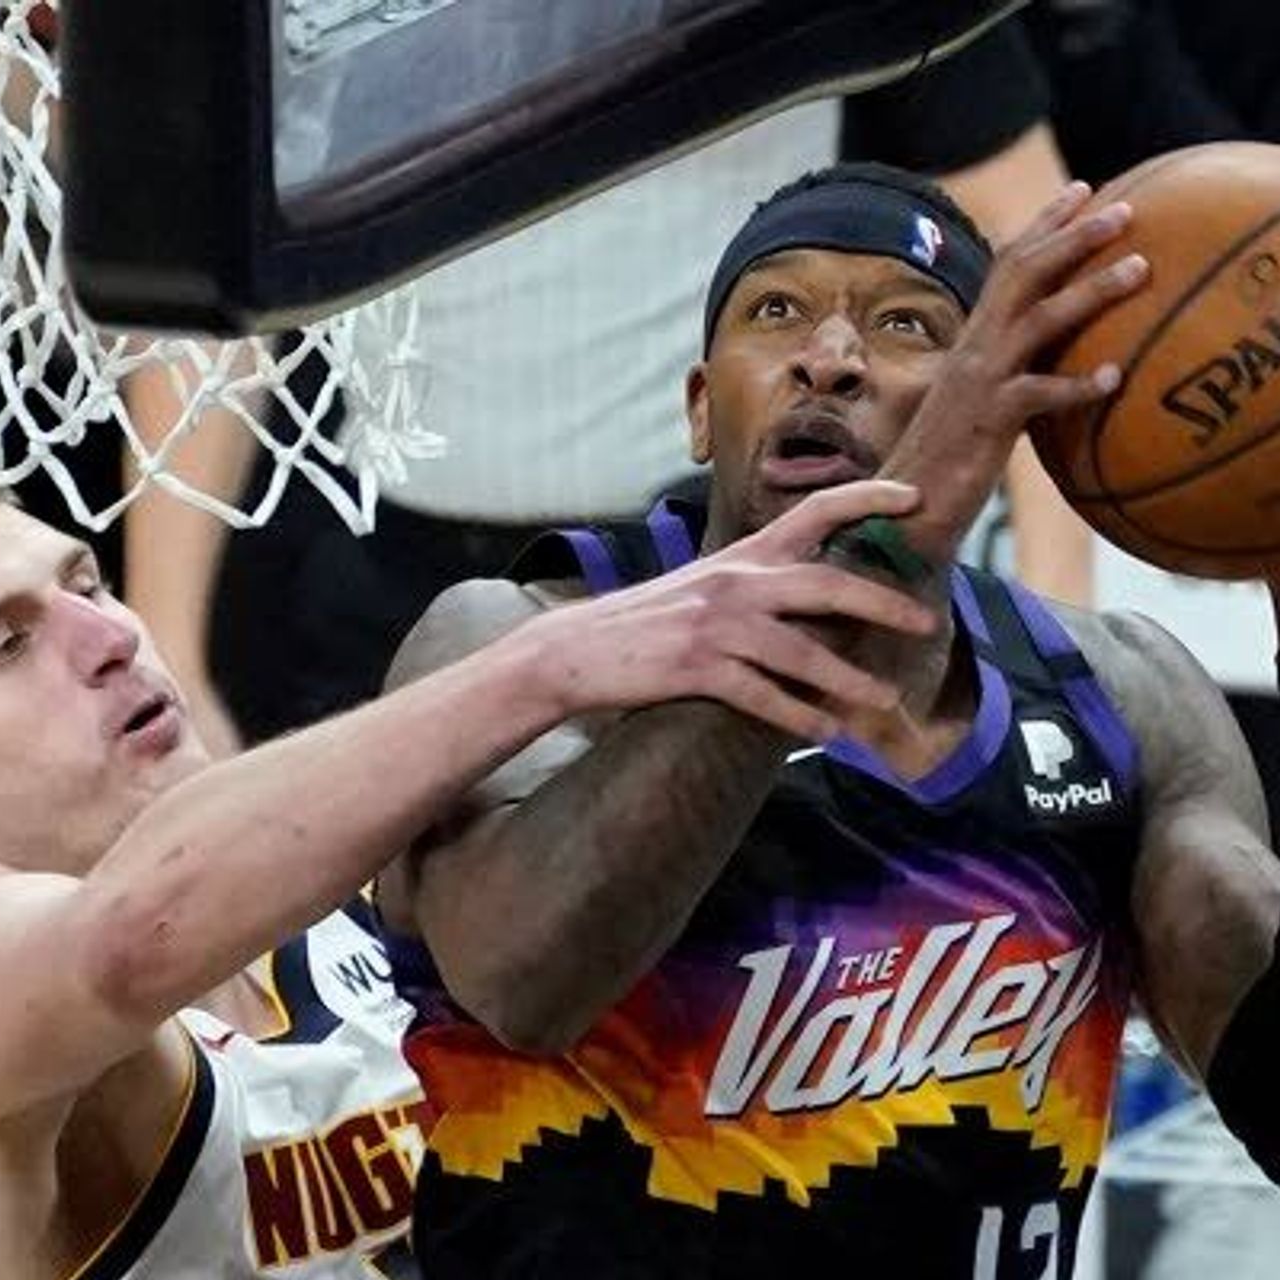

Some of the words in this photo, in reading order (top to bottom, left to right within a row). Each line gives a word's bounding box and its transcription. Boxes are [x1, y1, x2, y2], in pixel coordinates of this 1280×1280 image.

[1023, 778, 1112, 814] PayPal
[836, 945, 903, 990] THE
[703, 912, 1104, 1117] Valley
